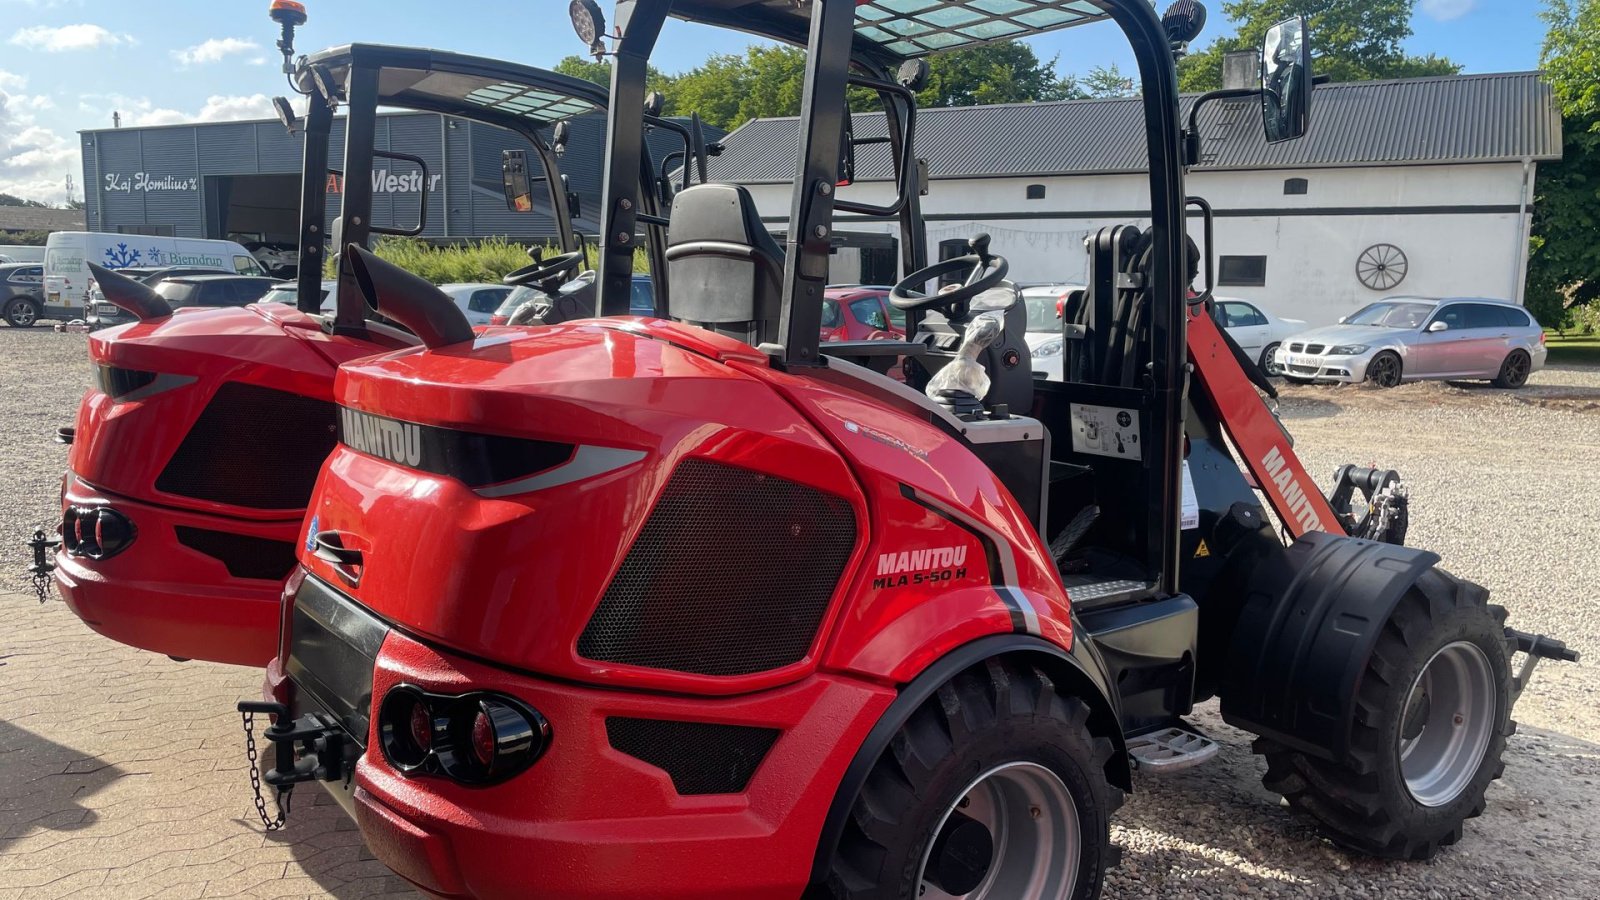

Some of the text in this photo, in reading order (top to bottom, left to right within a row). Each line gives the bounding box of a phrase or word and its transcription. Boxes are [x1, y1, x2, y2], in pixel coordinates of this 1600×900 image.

[105, 173, 131, 193] Kaj
[134, 172, 188, 192] Homilius
[341, 407, 420, 467] MANITOU
[1261, 445, 1327, 533] MANITO
[877, 545, 967, 576] MANITOU
[873, 568, 967, 590] MLA 5-50 H
